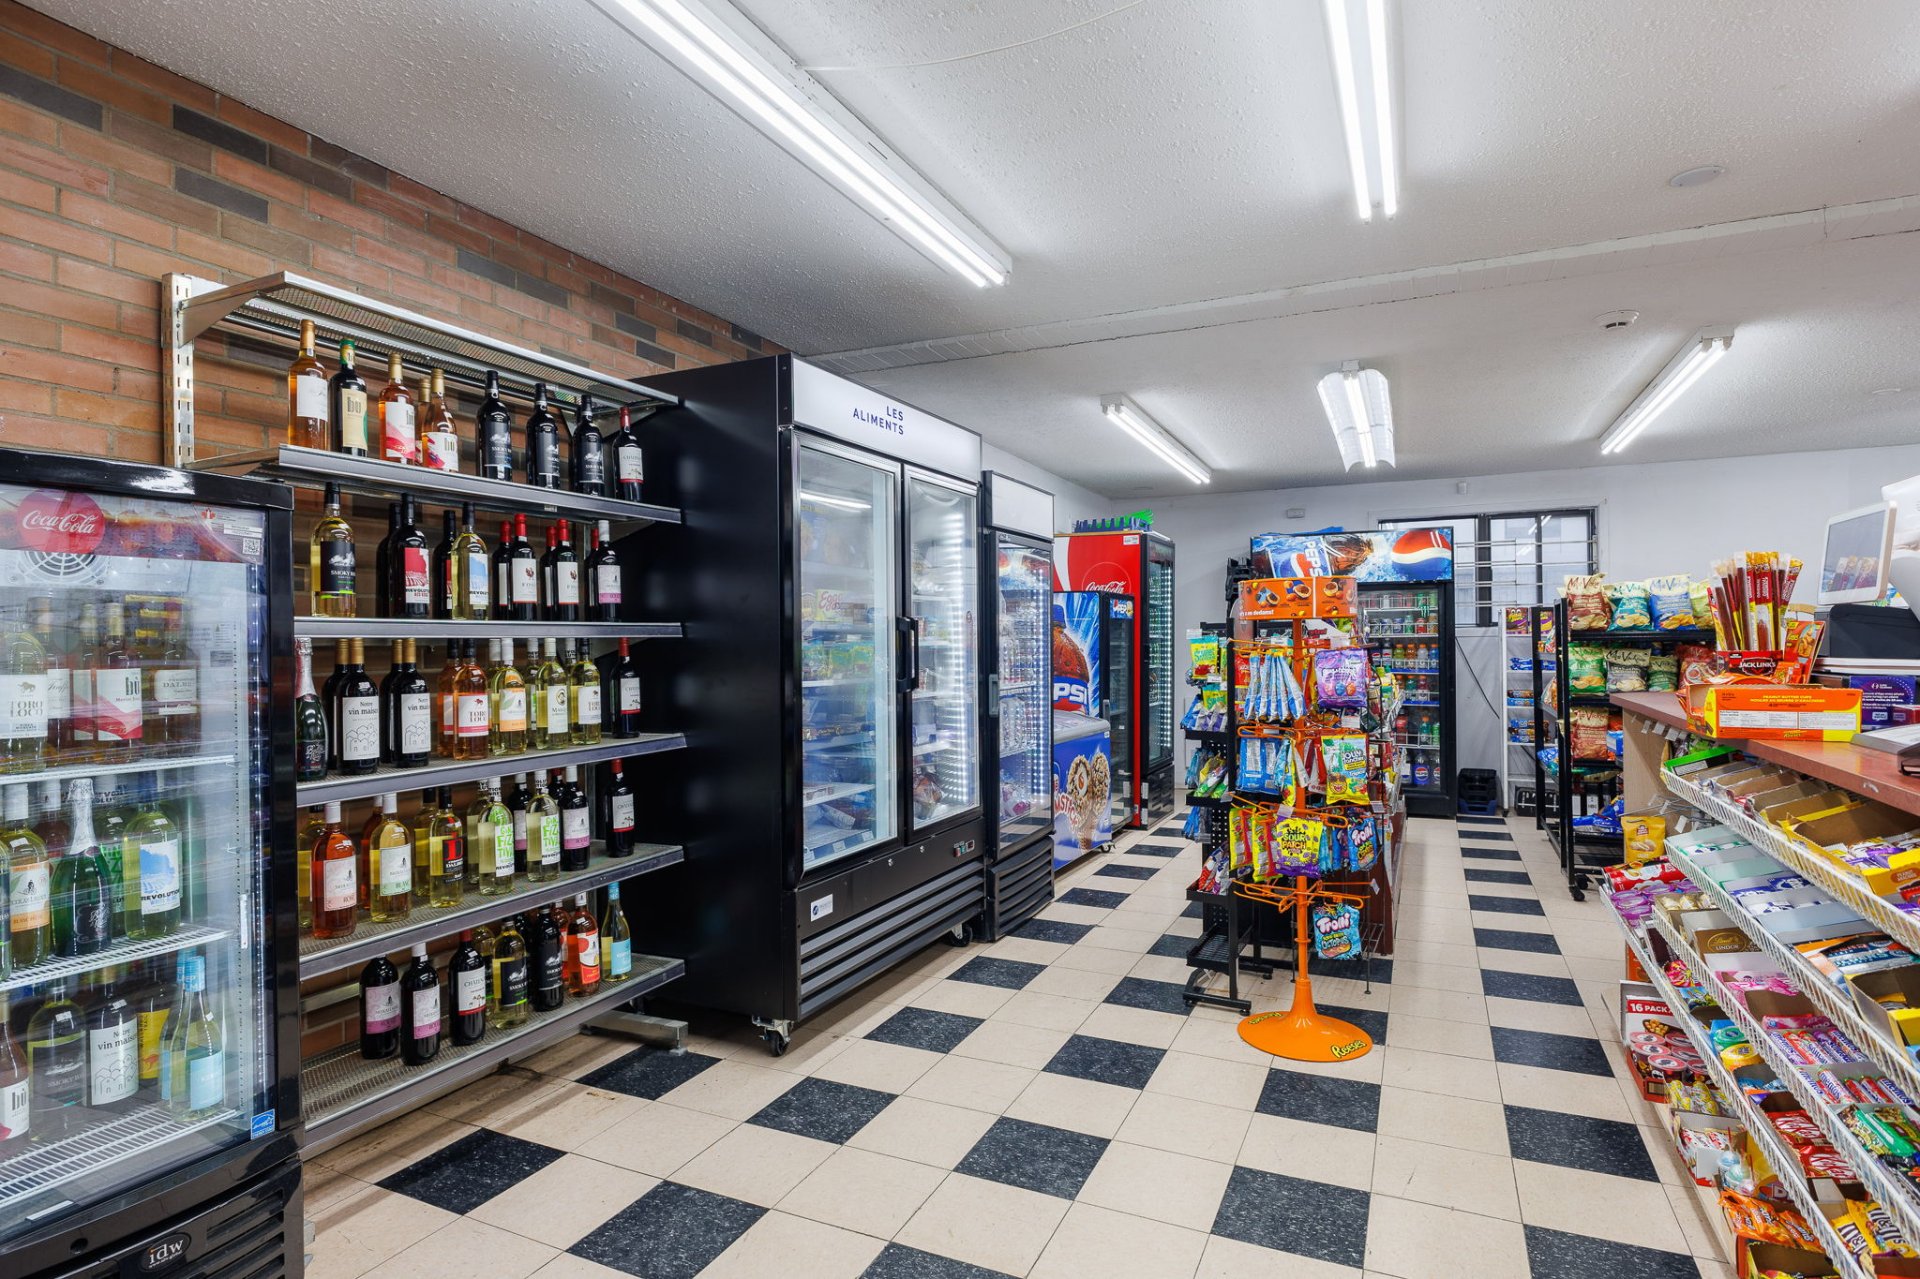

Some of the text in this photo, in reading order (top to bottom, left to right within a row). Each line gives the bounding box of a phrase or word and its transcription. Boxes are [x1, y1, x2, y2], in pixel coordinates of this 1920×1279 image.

[886, 405, 904, 421] LES
[853, 408, 904, 435] ALIMENTS
[22, 510, 95, 535] Coca-Cola
[349, 707, 360, 715] vin
[1283, 833, 1305, 842] SOUR
[1281, 841, 1306, 850] PATCH
[1317, 912, 1350, 933] Trolli
[1630, 1002, 1668, 1014] 16 PACK
[97, 1042, 113, 1051] vin
[149, 1240, 184, 1265] idw
